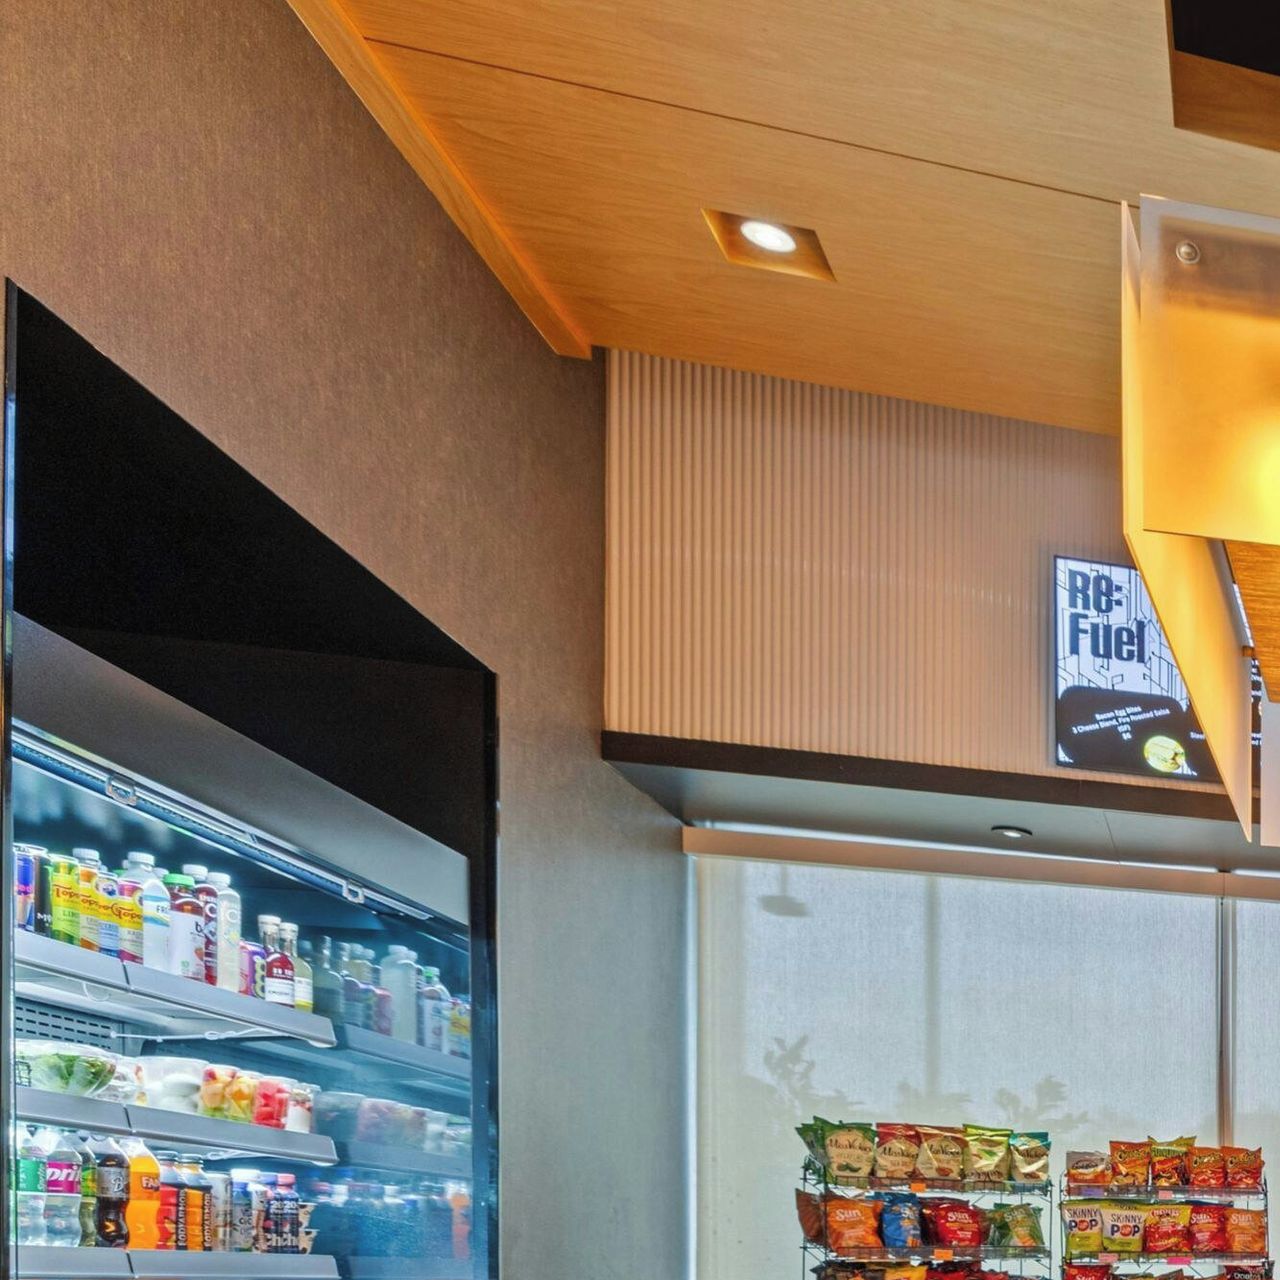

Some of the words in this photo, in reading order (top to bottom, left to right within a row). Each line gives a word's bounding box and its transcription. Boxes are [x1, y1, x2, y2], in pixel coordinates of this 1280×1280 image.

[1069, 611, 1146, 665] Fuel
[836, 1208, 862, 1222] Sun
[947, 1211, 970, 1223] Sun
[1067, 1207, 1100, 1218] SKINNY
[1110, 1213, 1143, 1224] SKINNY
[1068, 1218, 1099, 1232] POP
[1110, 1223, 1140, 1237] POP
